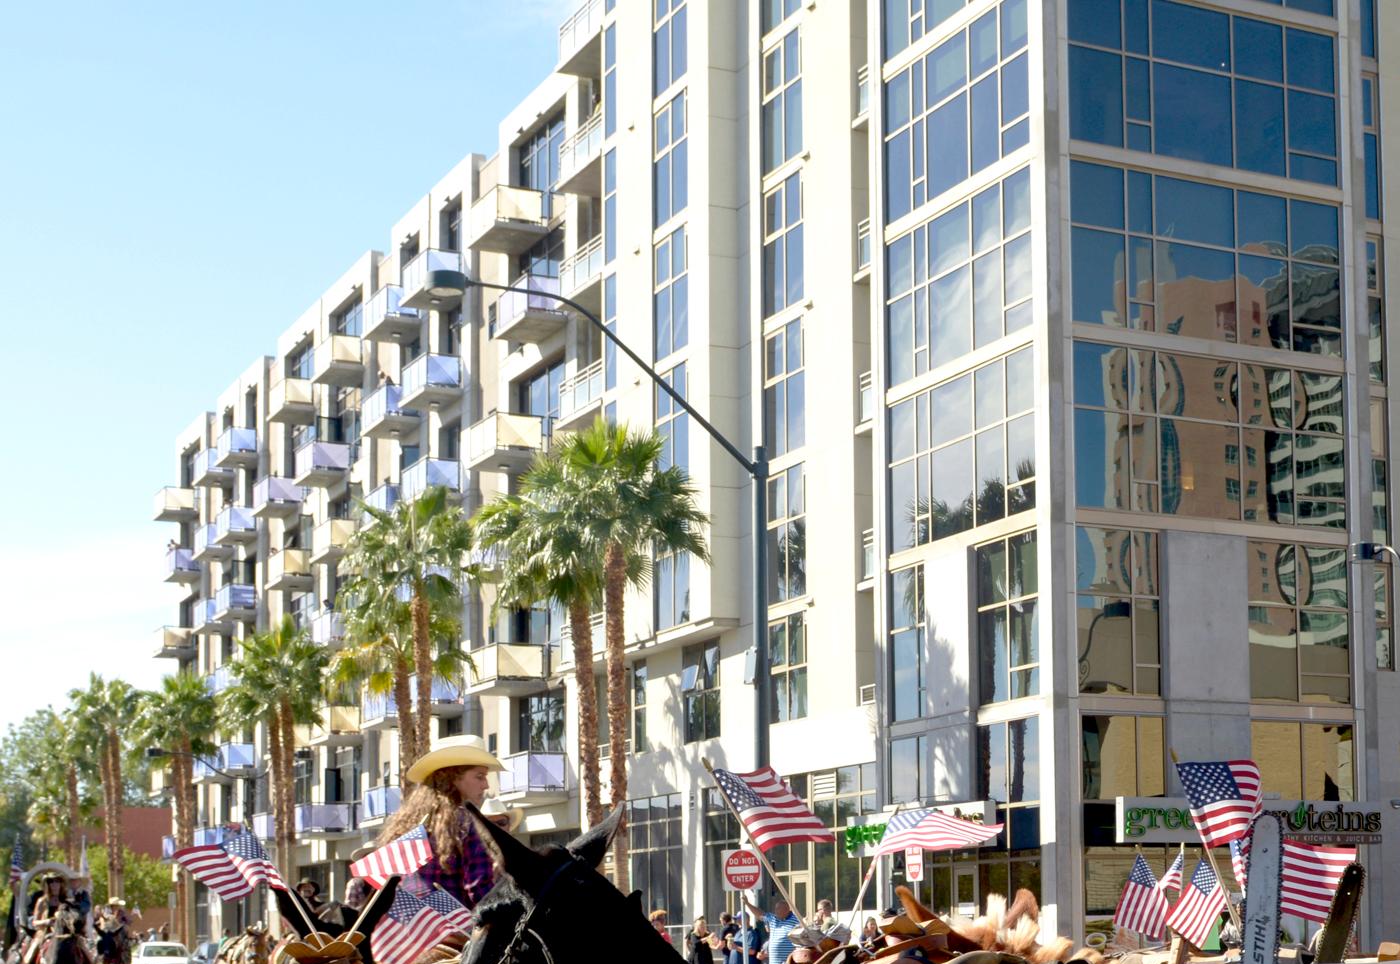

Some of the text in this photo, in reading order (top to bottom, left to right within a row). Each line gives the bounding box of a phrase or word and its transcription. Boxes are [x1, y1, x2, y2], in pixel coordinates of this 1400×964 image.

[1126, 801, 1382, 838] gree roteins
[1303, 834, 1332, 842] KITCHEN
[742, 857, 755, 865] NOT
[732, 875, 754, 883] ENTER
[1253, 918, 1267, 964] STIHL
